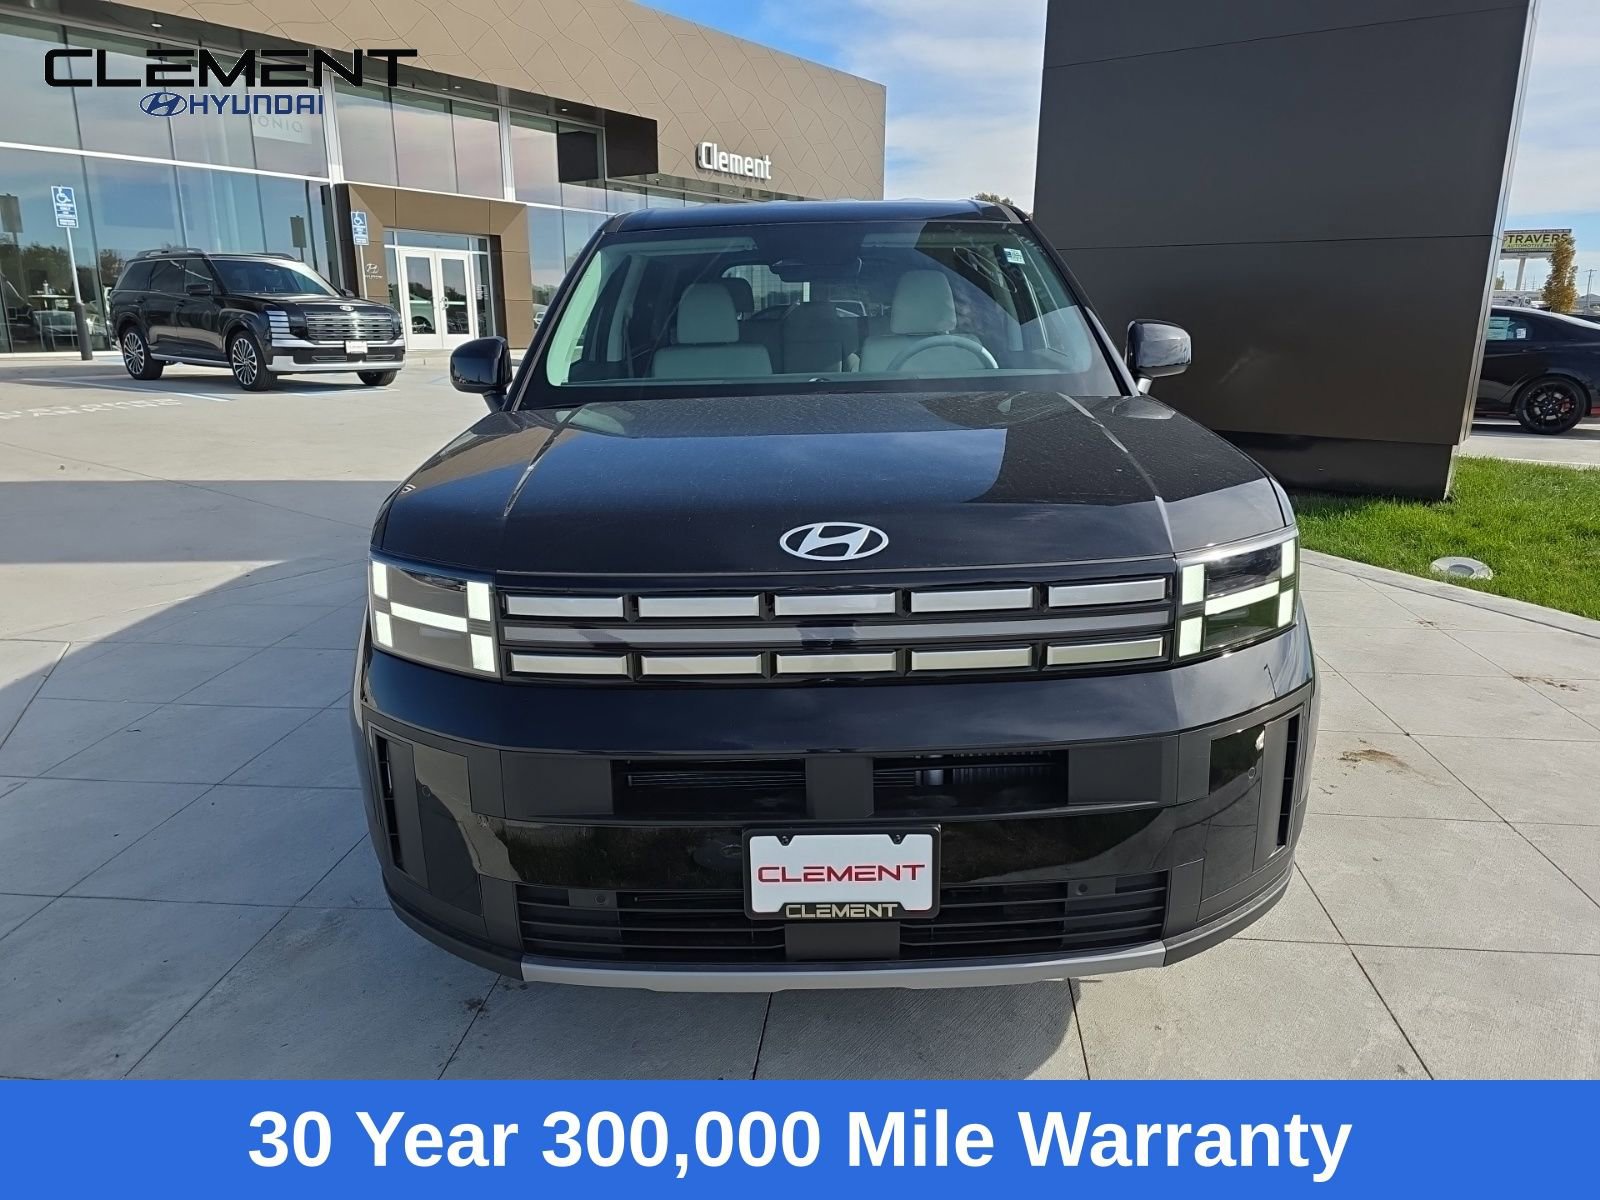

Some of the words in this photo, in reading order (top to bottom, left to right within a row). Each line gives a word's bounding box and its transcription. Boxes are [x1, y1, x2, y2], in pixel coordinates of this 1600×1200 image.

[699, 141, 772, 180] Clement
[758, 865, 925, 882] CLEMENT
[785, 903, 899, 918] CLEMENT
